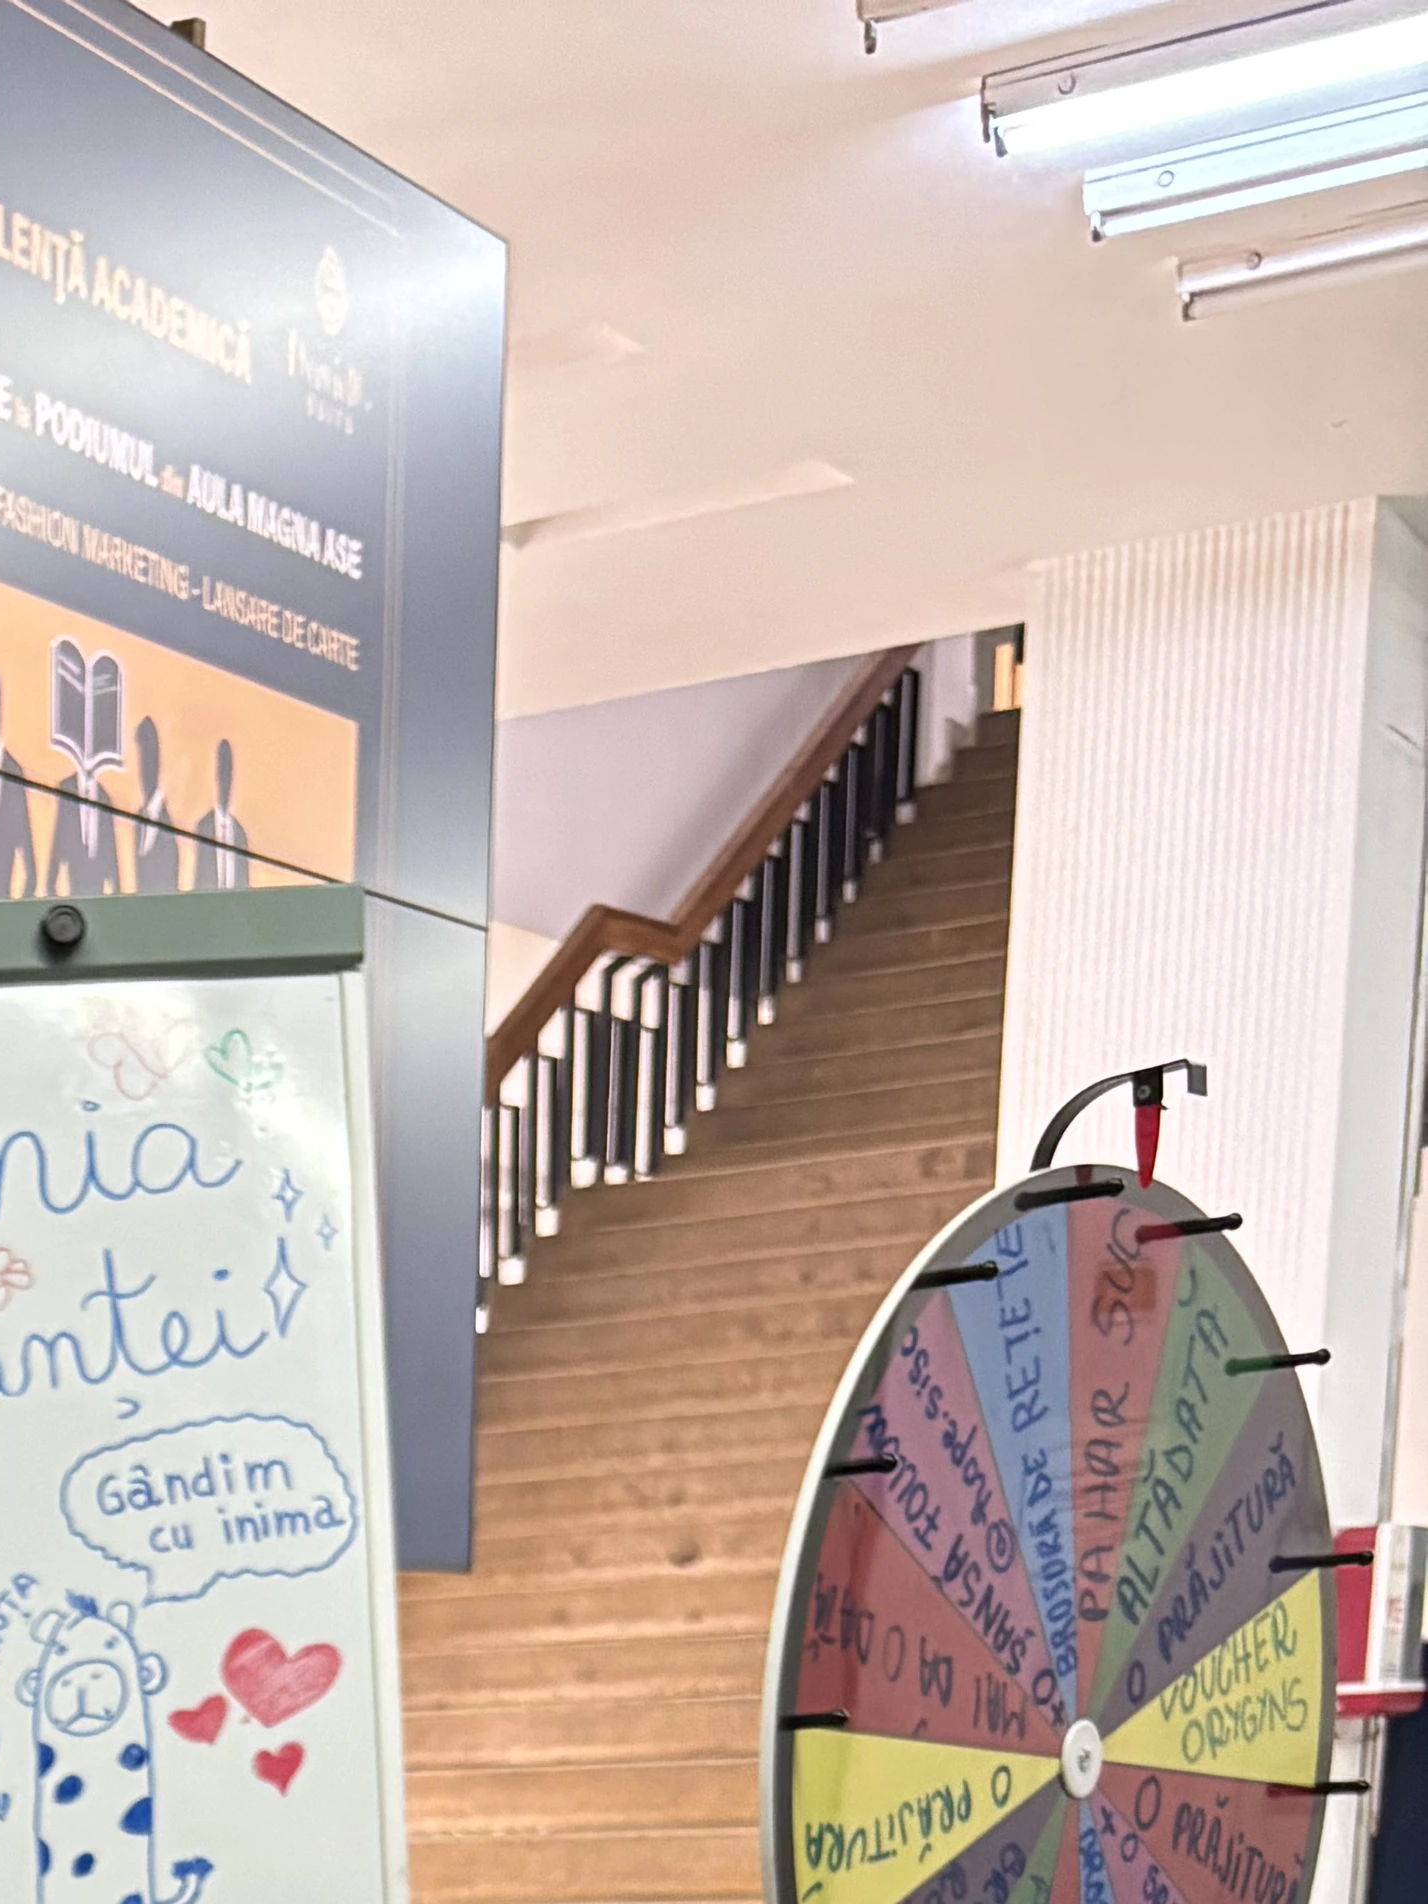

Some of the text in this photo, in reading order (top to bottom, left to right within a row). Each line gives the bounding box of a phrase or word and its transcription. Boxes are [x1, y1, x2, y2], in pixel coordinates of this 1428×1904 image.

[35, 393, 158, 488] PODIUMUL
[187, 463, 244, 528] AULA
[247, 491, 321, 560] MAGNA
[321, 527, 364, 579] ASE
[81, 524, 190, 600] MARKETING
[202, 576, 280, 641] LANSARE
[281, 611, 306, 650] DE
[307, 620, 361, 672] CARTE
[1076, 1208, 1143, 1624] PAHAR SUC
[97, 1453, 293, 1517] Gândim
[149, 1521, 194, 1553] cu
[1160, 1600, 1298, 1722] VOUCHER
[991, 1765, 1012, 1807] O
[1134, 1776, 1161, 1830] O
